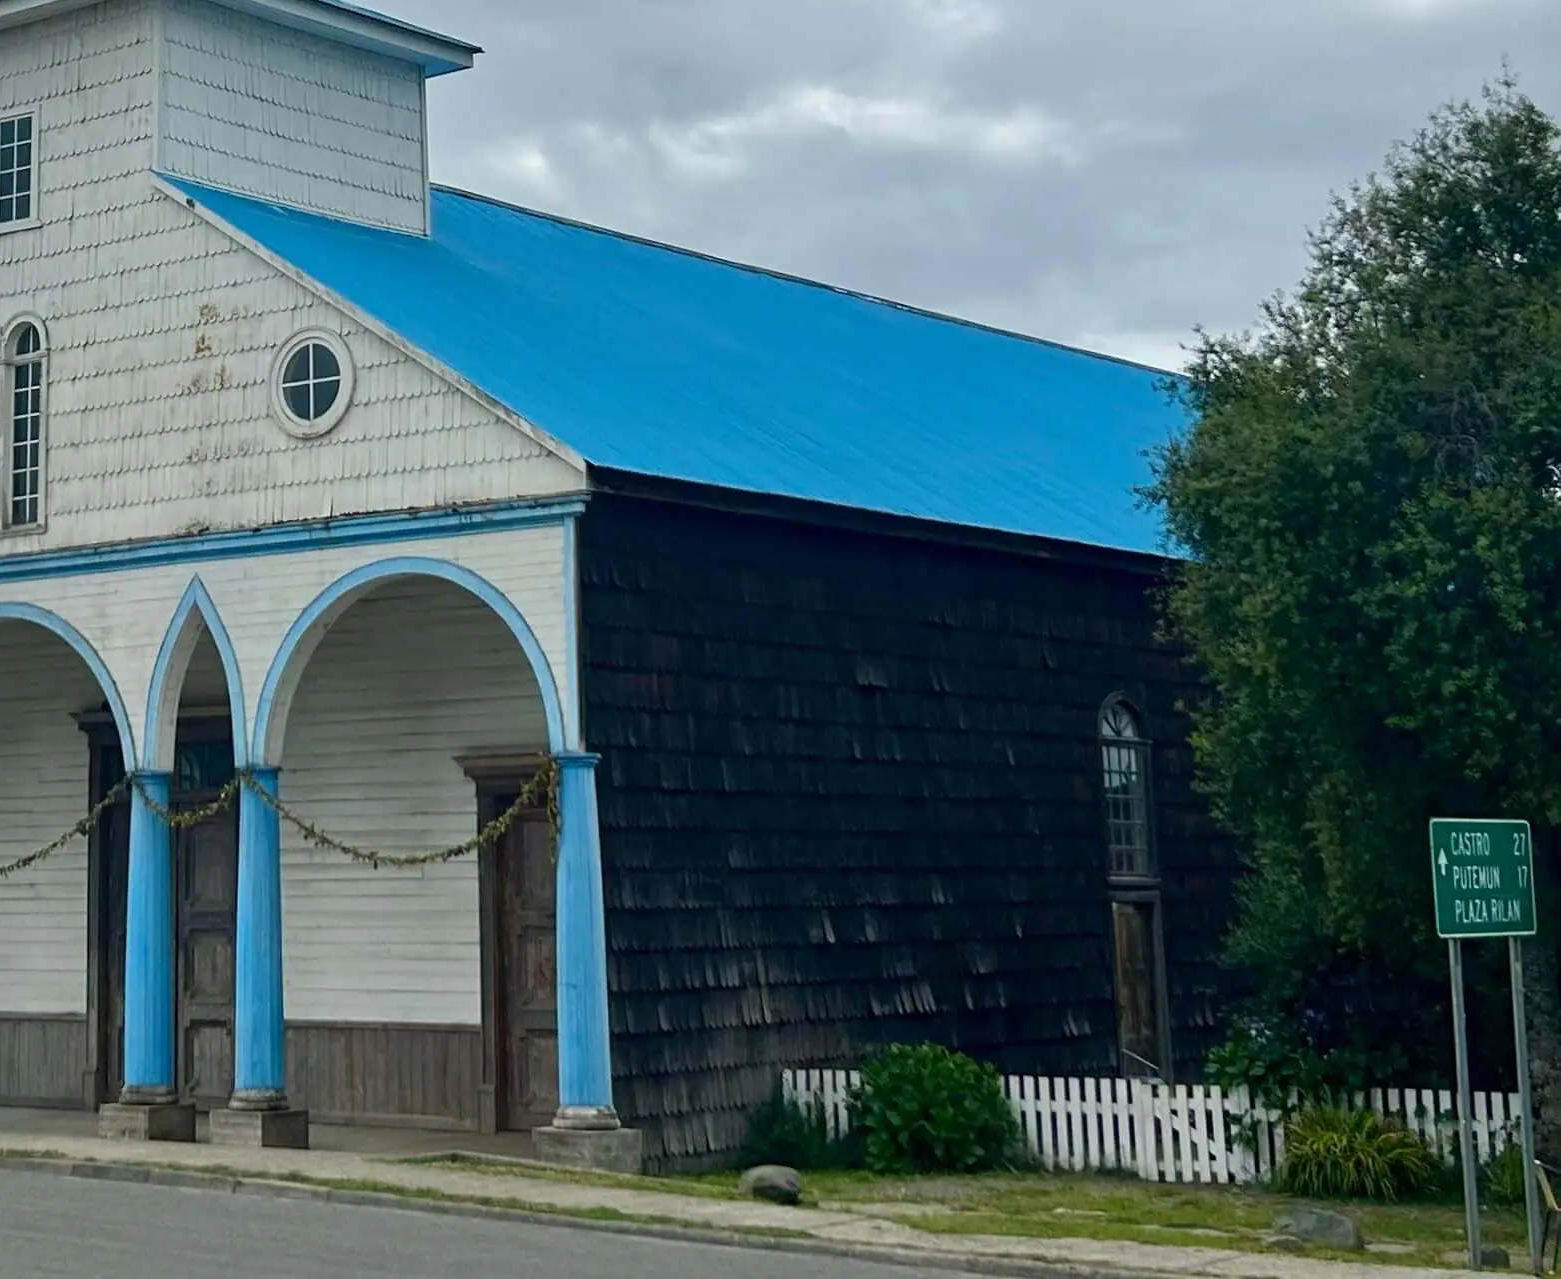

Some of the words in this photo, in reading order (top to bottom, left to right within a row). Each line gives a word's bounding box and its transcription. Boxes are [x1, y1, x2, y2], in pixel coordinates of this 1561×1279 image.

[1450, 831, 1491, 857] CASTRO
[1512, 832, 1526, 857] 27
[1452, 865, 1501, 890] PUTEMUN
[1517, 865, 1528, 889] 17
[1454, 898, 1489, 924] PLAZA
[1491, 898, 1521, 922] RILAN
